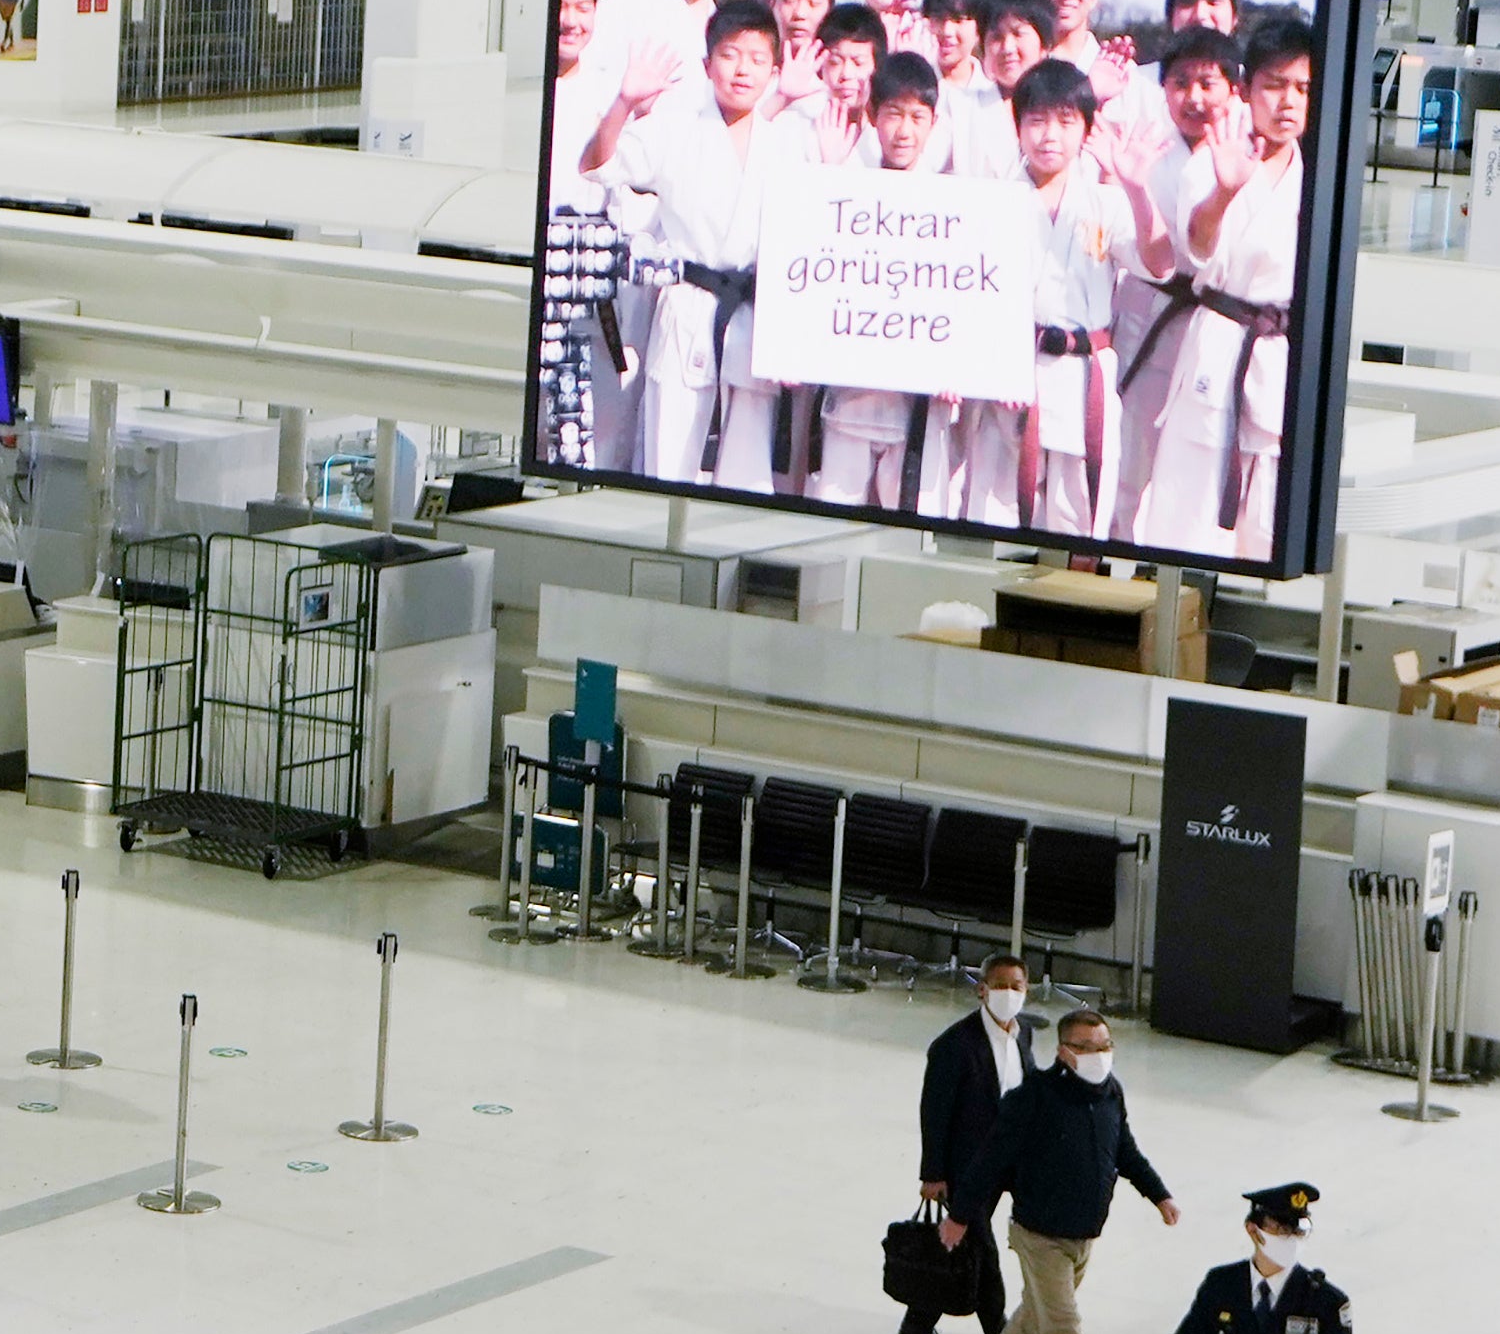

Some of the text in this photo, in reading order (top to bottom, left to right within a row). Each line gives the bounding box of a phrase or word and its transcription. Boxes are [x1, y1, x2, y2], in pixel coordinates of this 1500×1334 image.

[828, 198, 961, 239] Tekrar
[787, 247, 999, 300] görüşmek
[833, 298, 950, 343] üzere
[1185, 820, 1272, 848] STARLUX
